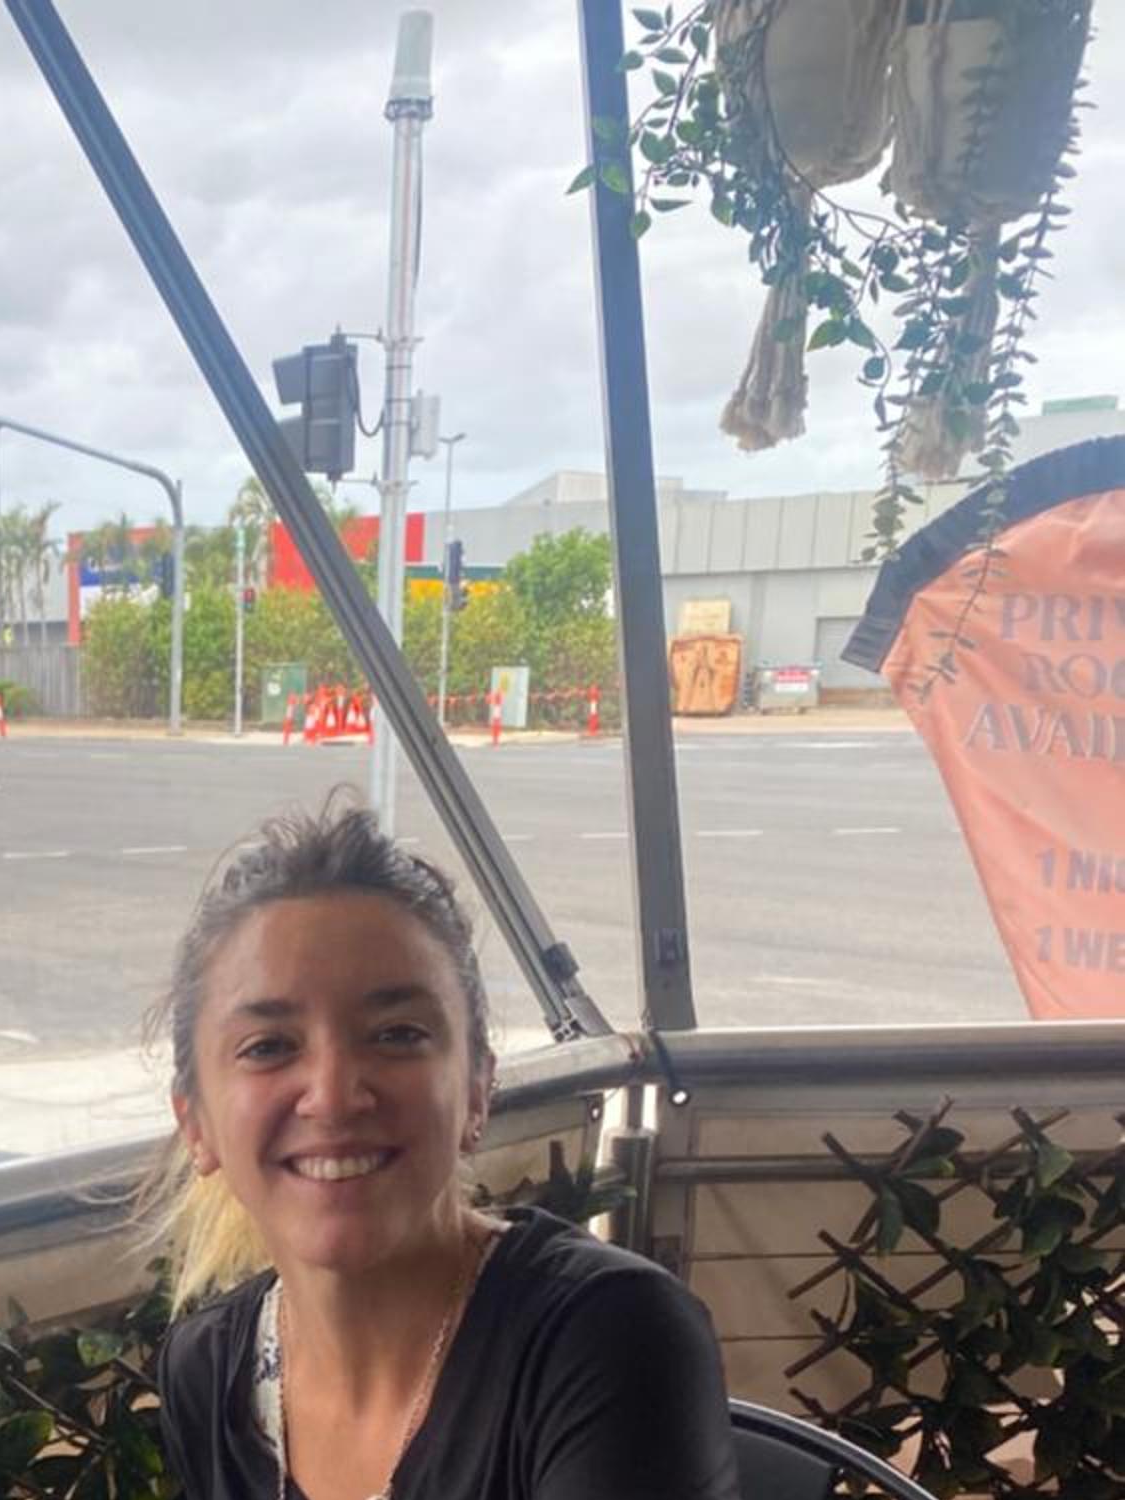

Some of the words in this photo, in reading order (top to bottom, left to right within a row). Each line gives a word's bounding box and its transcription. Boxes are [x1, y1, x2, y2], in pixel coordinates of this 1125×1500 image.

[1002, 592, 1125, 641] PRI
[1019, 653, 1125, 699] RO
[1036, 847, 1054, 888] 1
[1036, 925, 1052, 962] 1
